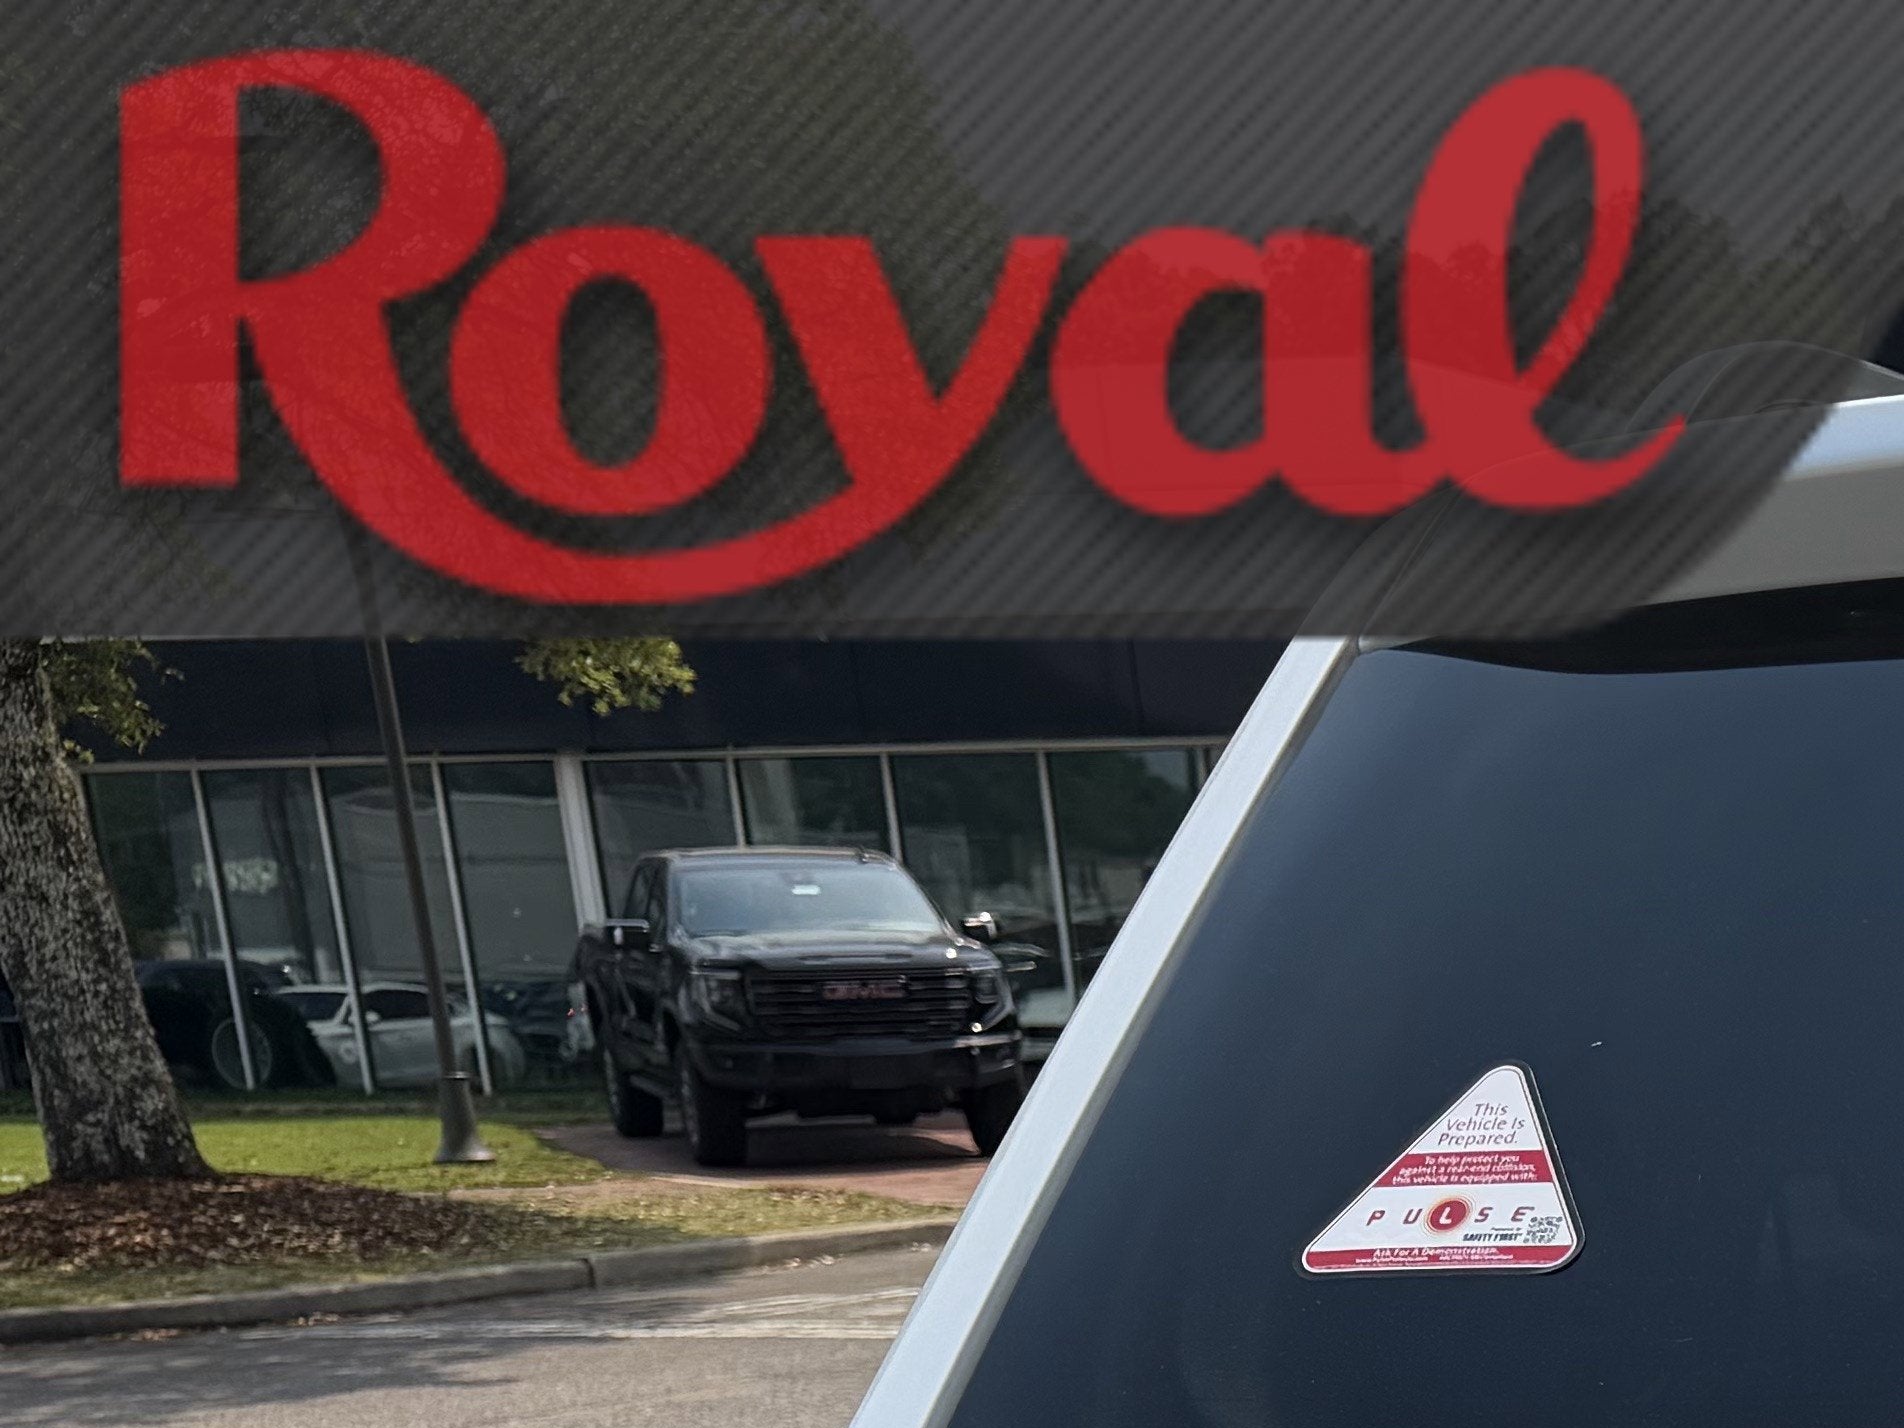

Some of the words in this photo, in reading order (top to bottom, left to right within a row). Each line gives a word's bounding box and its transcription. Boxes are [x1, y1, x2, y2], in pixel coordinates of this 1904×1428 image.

[1475, 1103, 1509, 1117] This
[1447, 1117, 1507, 1131] Vehicle
[1511, 1118, 1526, 1130] Is
[1438, 1131, 1518, 1148] Prepared.
[1366, 1206, 1535, 1226] PULSE
